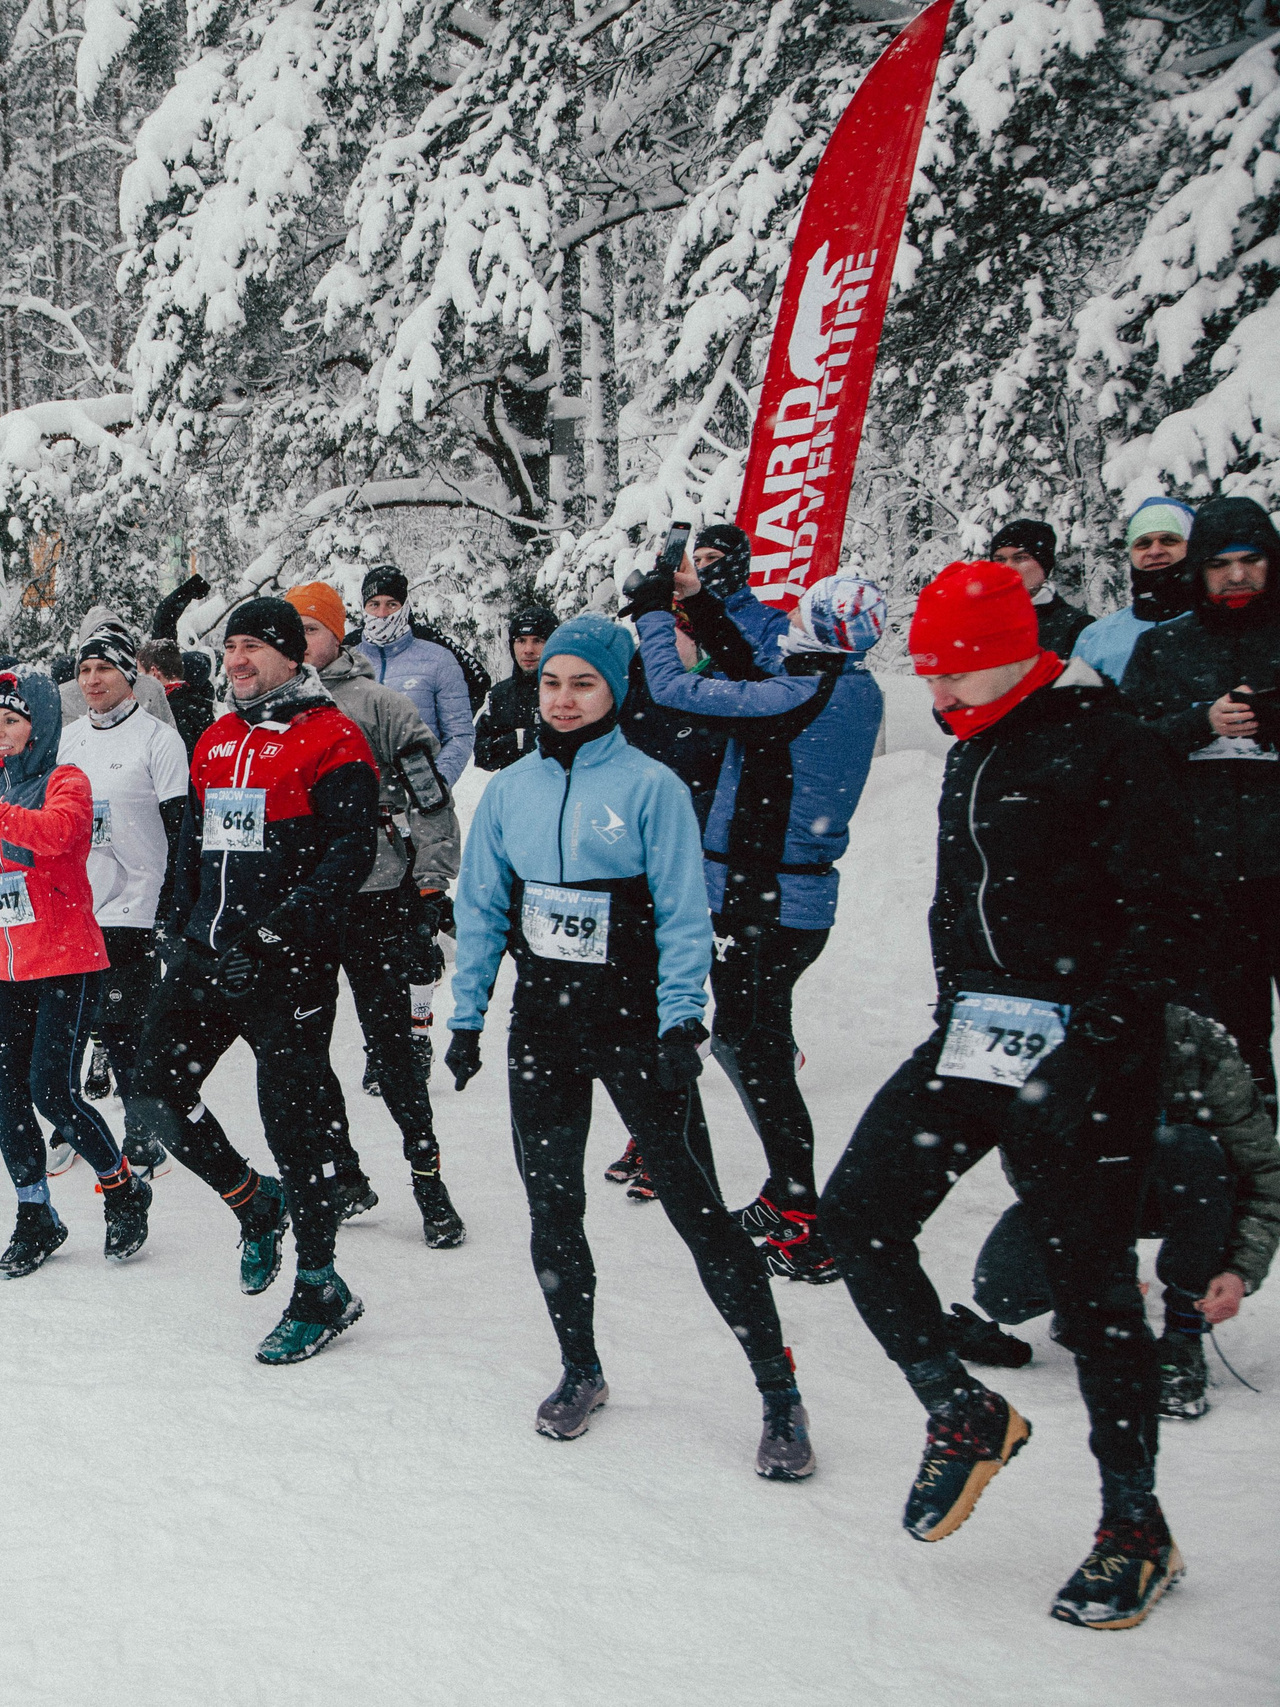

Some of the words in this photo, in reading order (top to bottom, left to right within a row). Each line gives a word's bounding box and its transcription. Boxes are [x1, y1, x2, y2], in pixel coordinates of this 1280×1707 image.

[783, 249, 879, 598] ADVENTURE
[750, 385, 820, 602] HARD
[219, 790, 244, 801] SNOW
[222, 810, 256, 831] 616
[544, 888, 580, 904] SNOW
[523, 903, 540, 917] T-7
[550, 912, 597, 939] 759
[982, 998, 1033, 1016] SNOW
[985, 1026, 1046, 1060] 739
